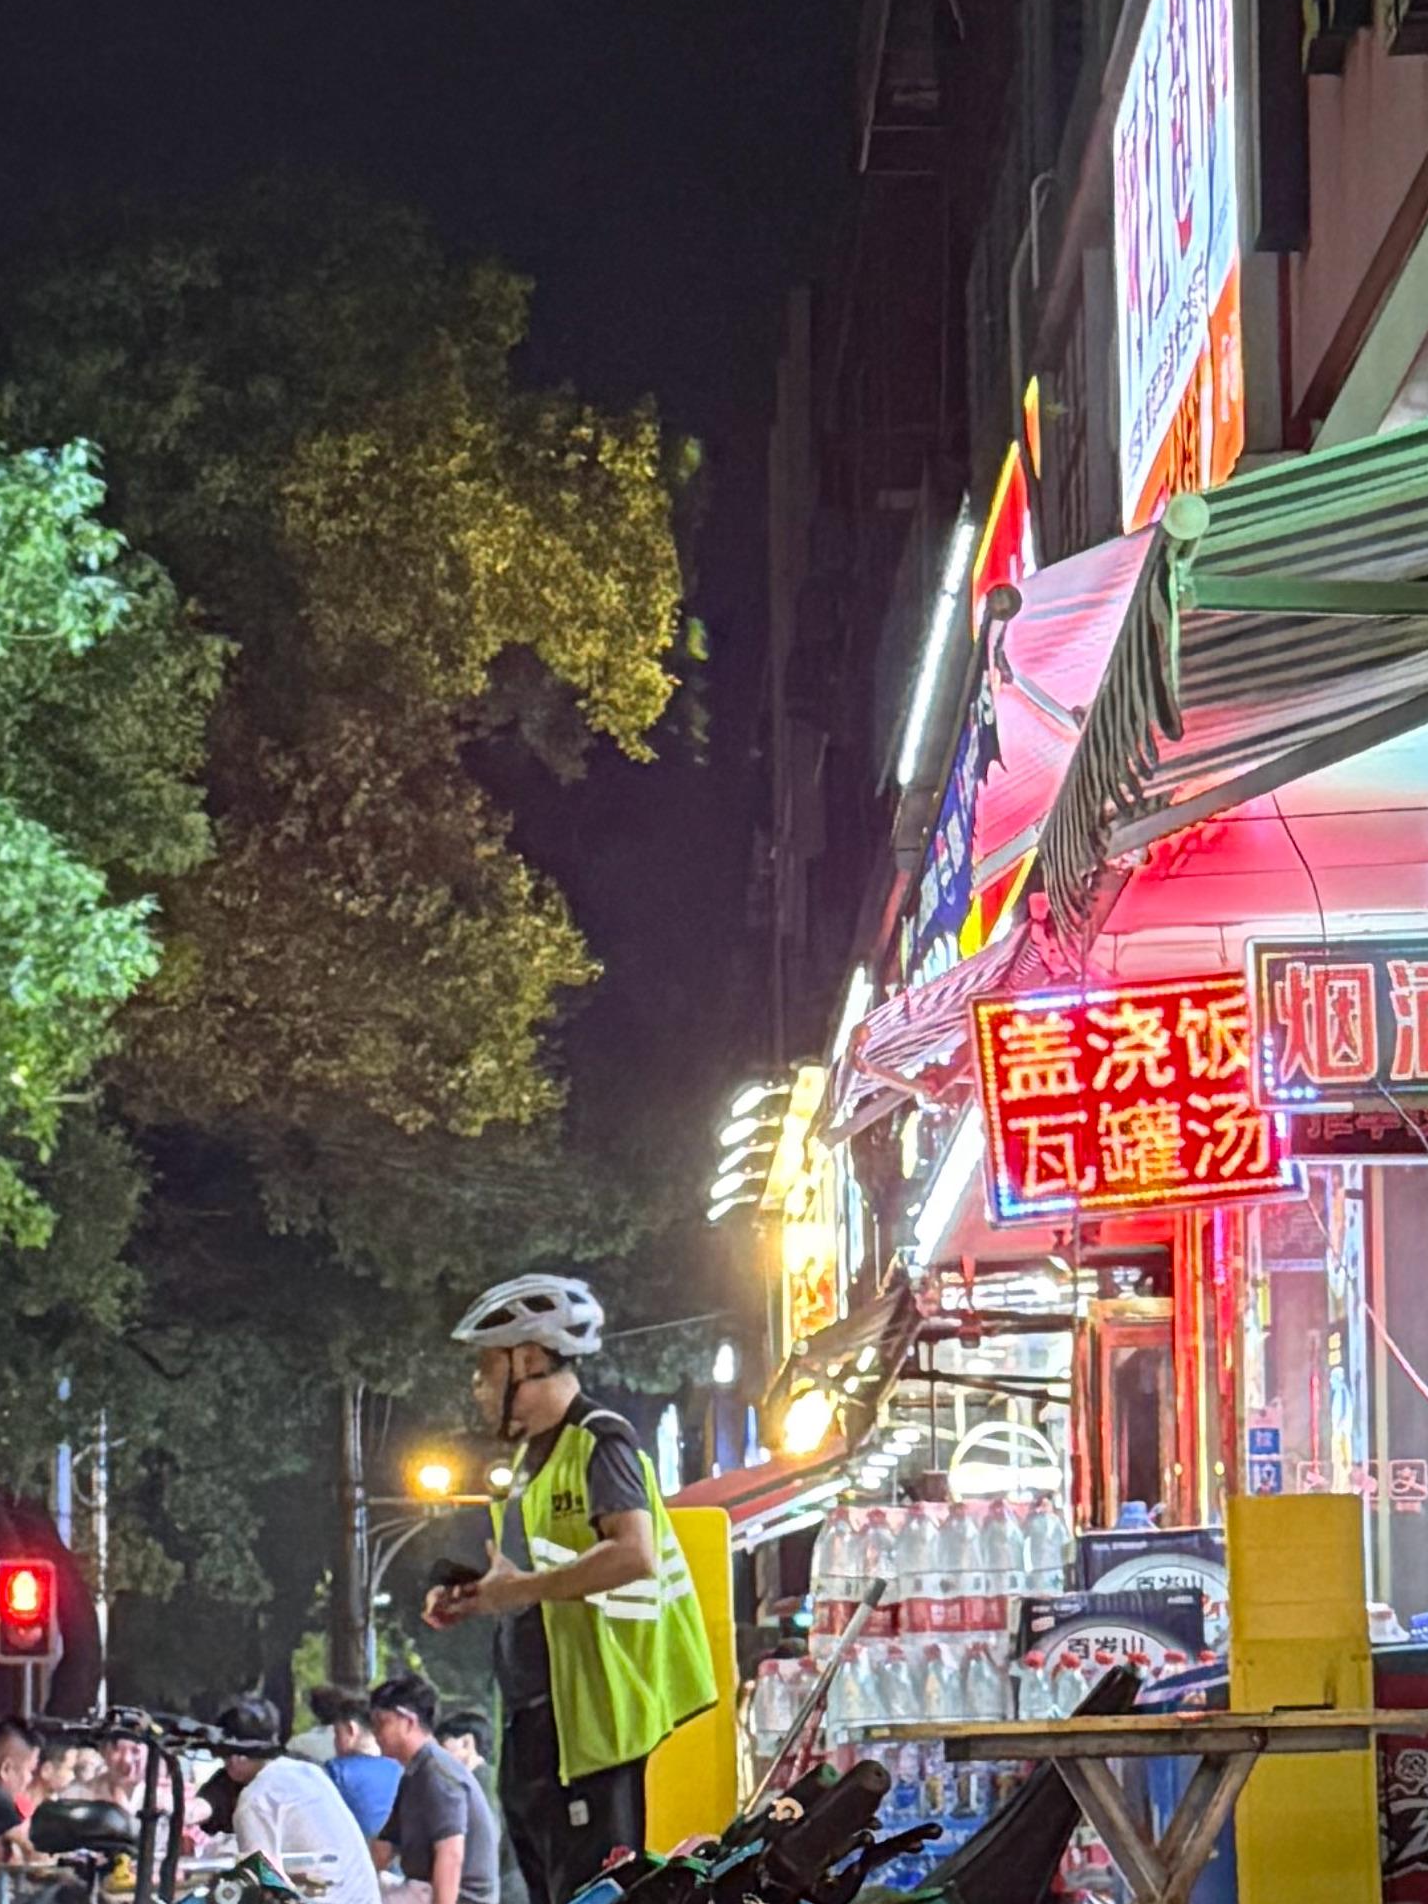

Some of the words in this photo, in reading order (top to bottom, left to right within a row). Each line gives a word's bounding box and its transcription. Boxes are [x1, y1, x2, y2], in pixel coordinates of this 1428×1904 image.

[999, 996, 1249, 1101] 盖浇饭
[1008, 1092, 1269, 1198] 瓦罐汤
